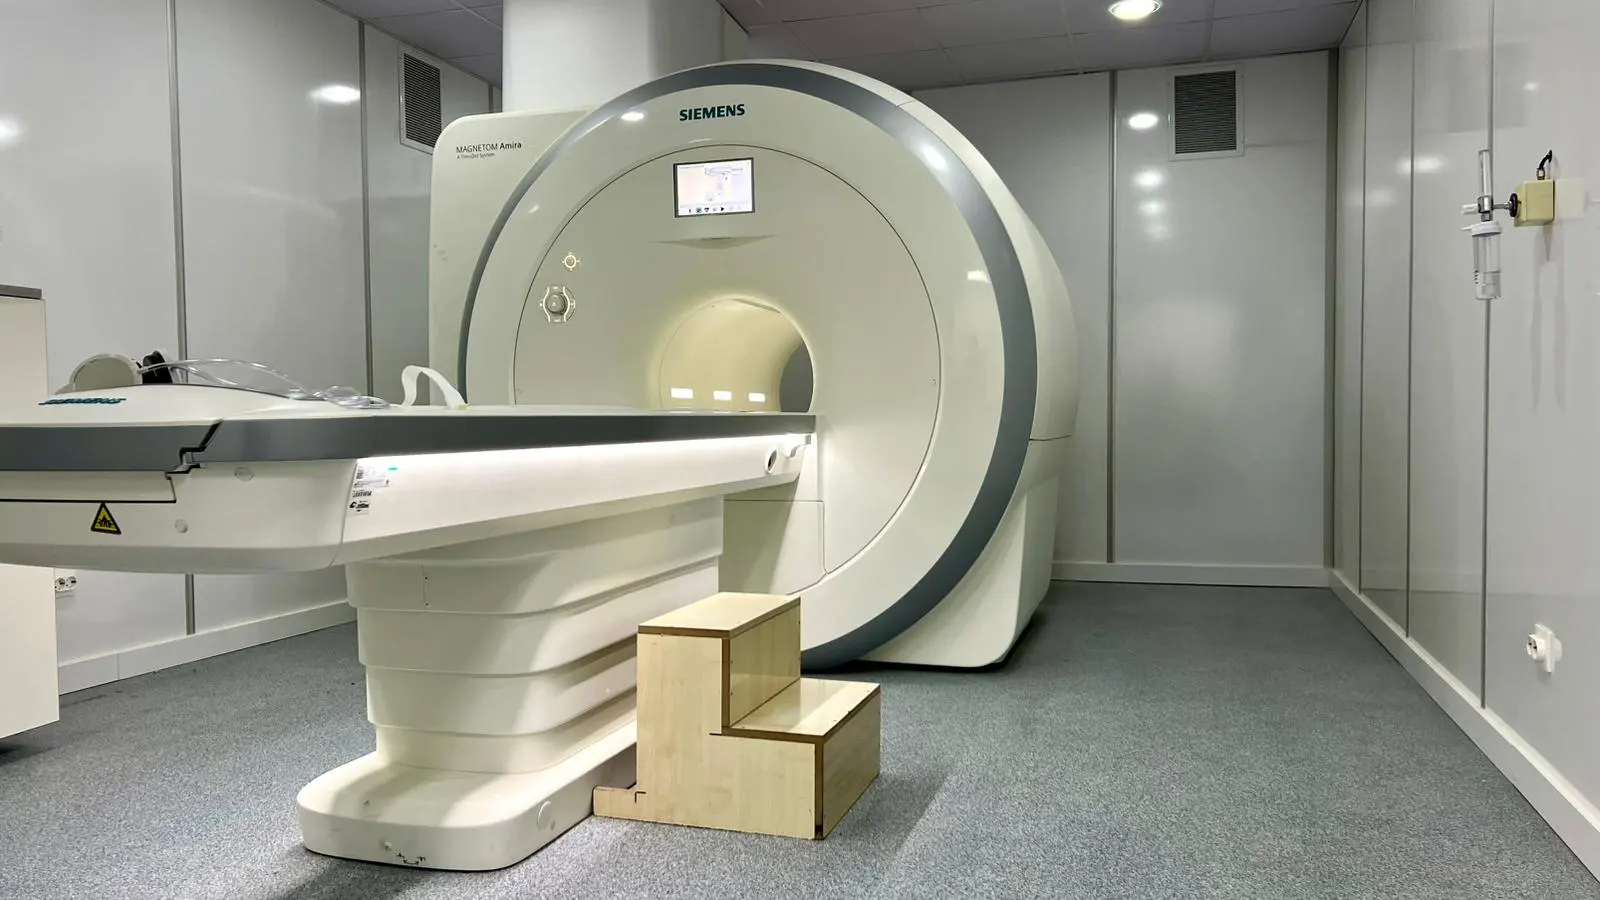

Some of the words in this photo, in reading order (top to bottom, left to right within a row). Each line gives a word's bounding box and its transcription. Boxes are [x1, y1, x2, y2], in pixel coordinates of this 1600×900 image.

[679, 104, 746, 121] SIEMENS
[456, 143, 498, 153] MAGNETOM
[499, 141, 522, 150] Amira
